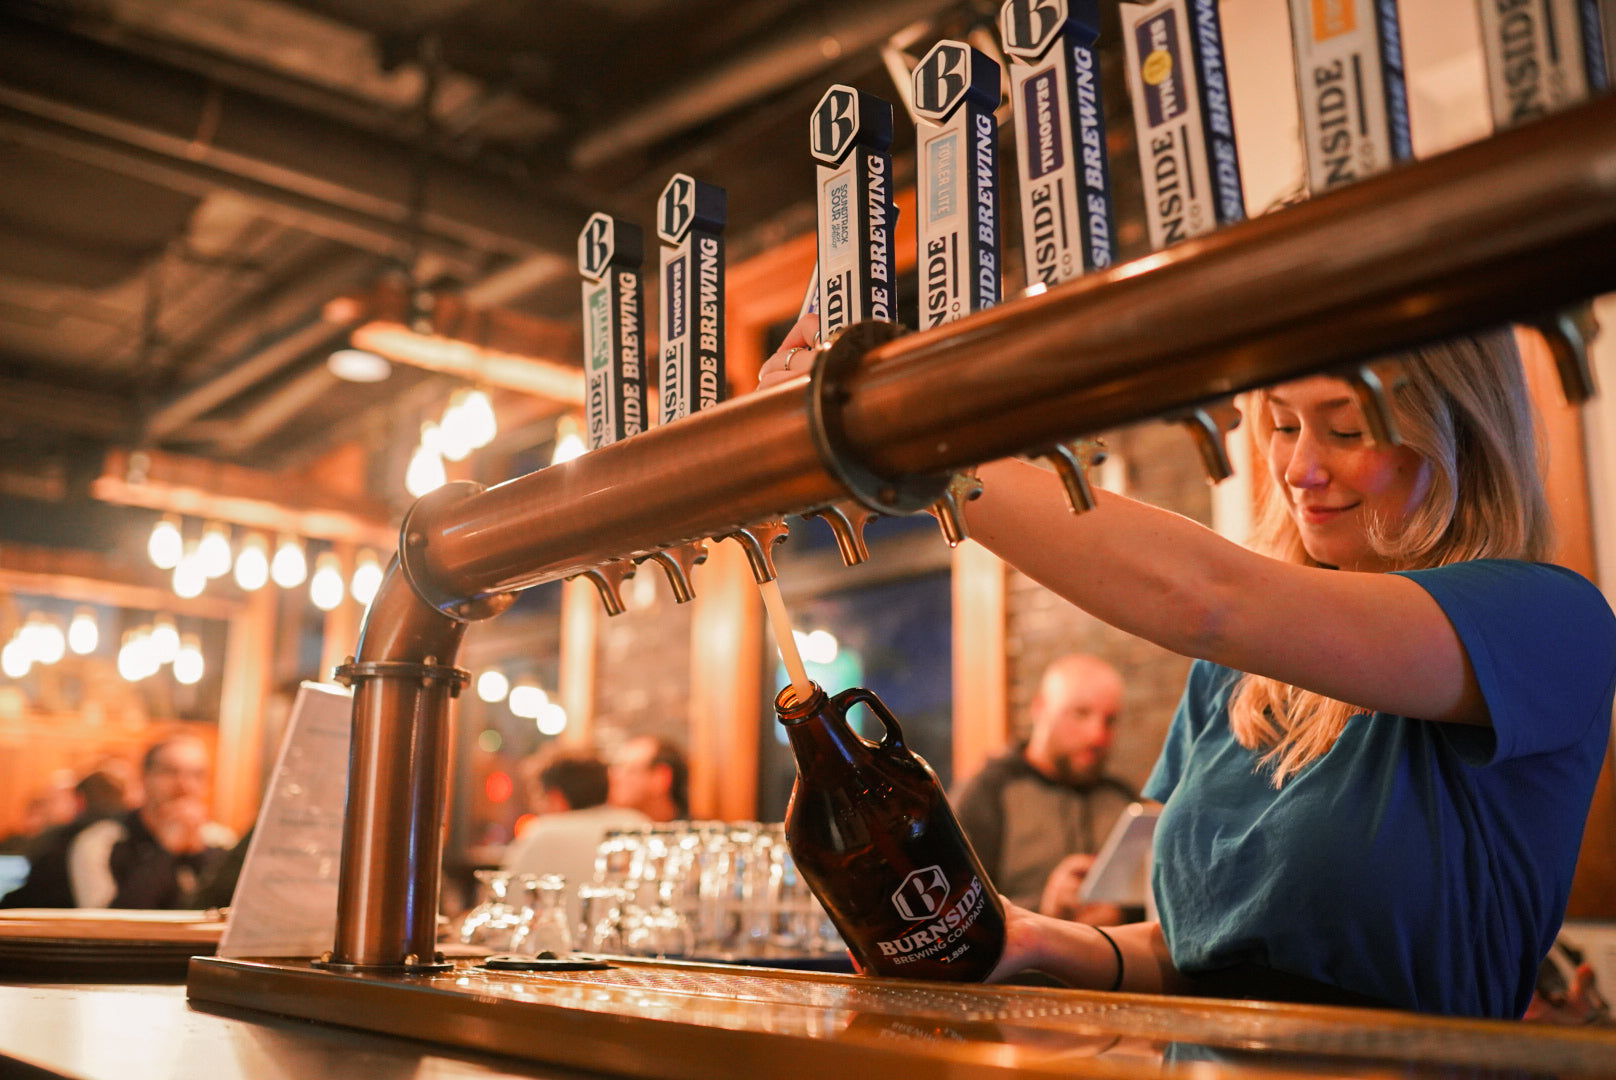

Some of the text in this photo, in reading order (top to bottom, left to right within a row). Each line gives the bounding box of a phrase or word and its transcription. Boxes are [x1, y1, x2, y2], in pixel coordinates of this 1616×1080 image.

[1036, 77, 1055, 174] SEASONAL
[1074, 46, 1105, 191] BREWING
[831, 187, 841, 221] SOUR
[840, 183, 849, 244] SOUNDTRACK
[868, 155, 889, 283] BREWING
[976, 114, 995, 248] BREWING
[619, 272, 640, 380] BREWING
[673, 262, 682, 337] SEASONAL
[700, 238, 718, 353] BREWING
[876, 874, 983, 956] BURNSIDE
[892, 895, 986, 965] BREWING COMPANY
